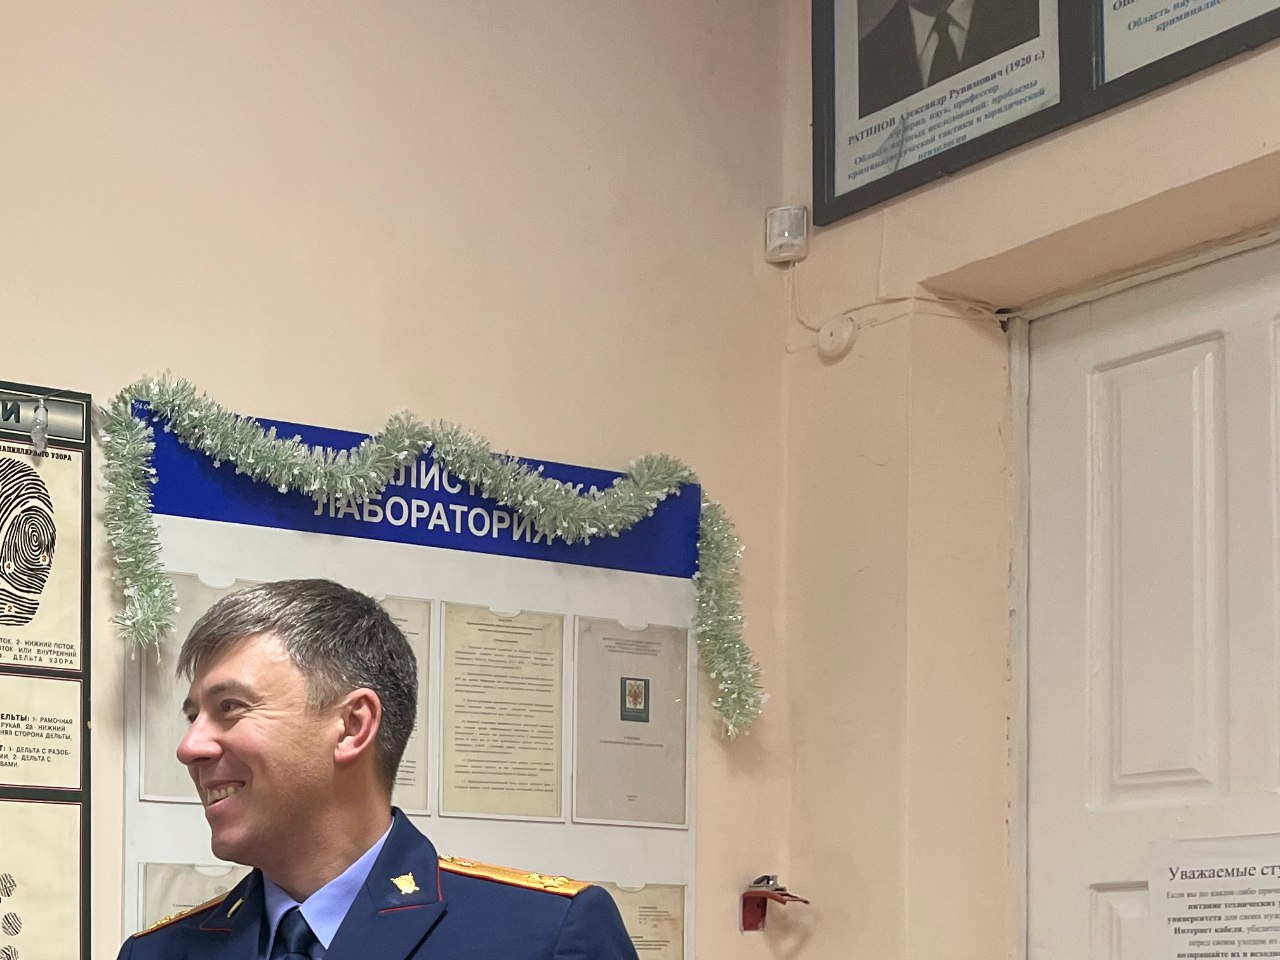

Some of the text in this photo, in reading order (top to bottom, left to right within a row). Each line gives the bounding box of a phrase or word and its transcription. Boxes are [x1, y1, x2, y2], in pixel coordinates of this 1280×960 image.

[848, 117, 895, 145] РАТИНОВ
[1005, 54, 1031, 75] (1920
[51, 452, 71, 460] УЗОРА
[36, 648, 76, 657] ВНУТРЕННИЙ
[1168, 866, 1256, 880] Уважаемые
